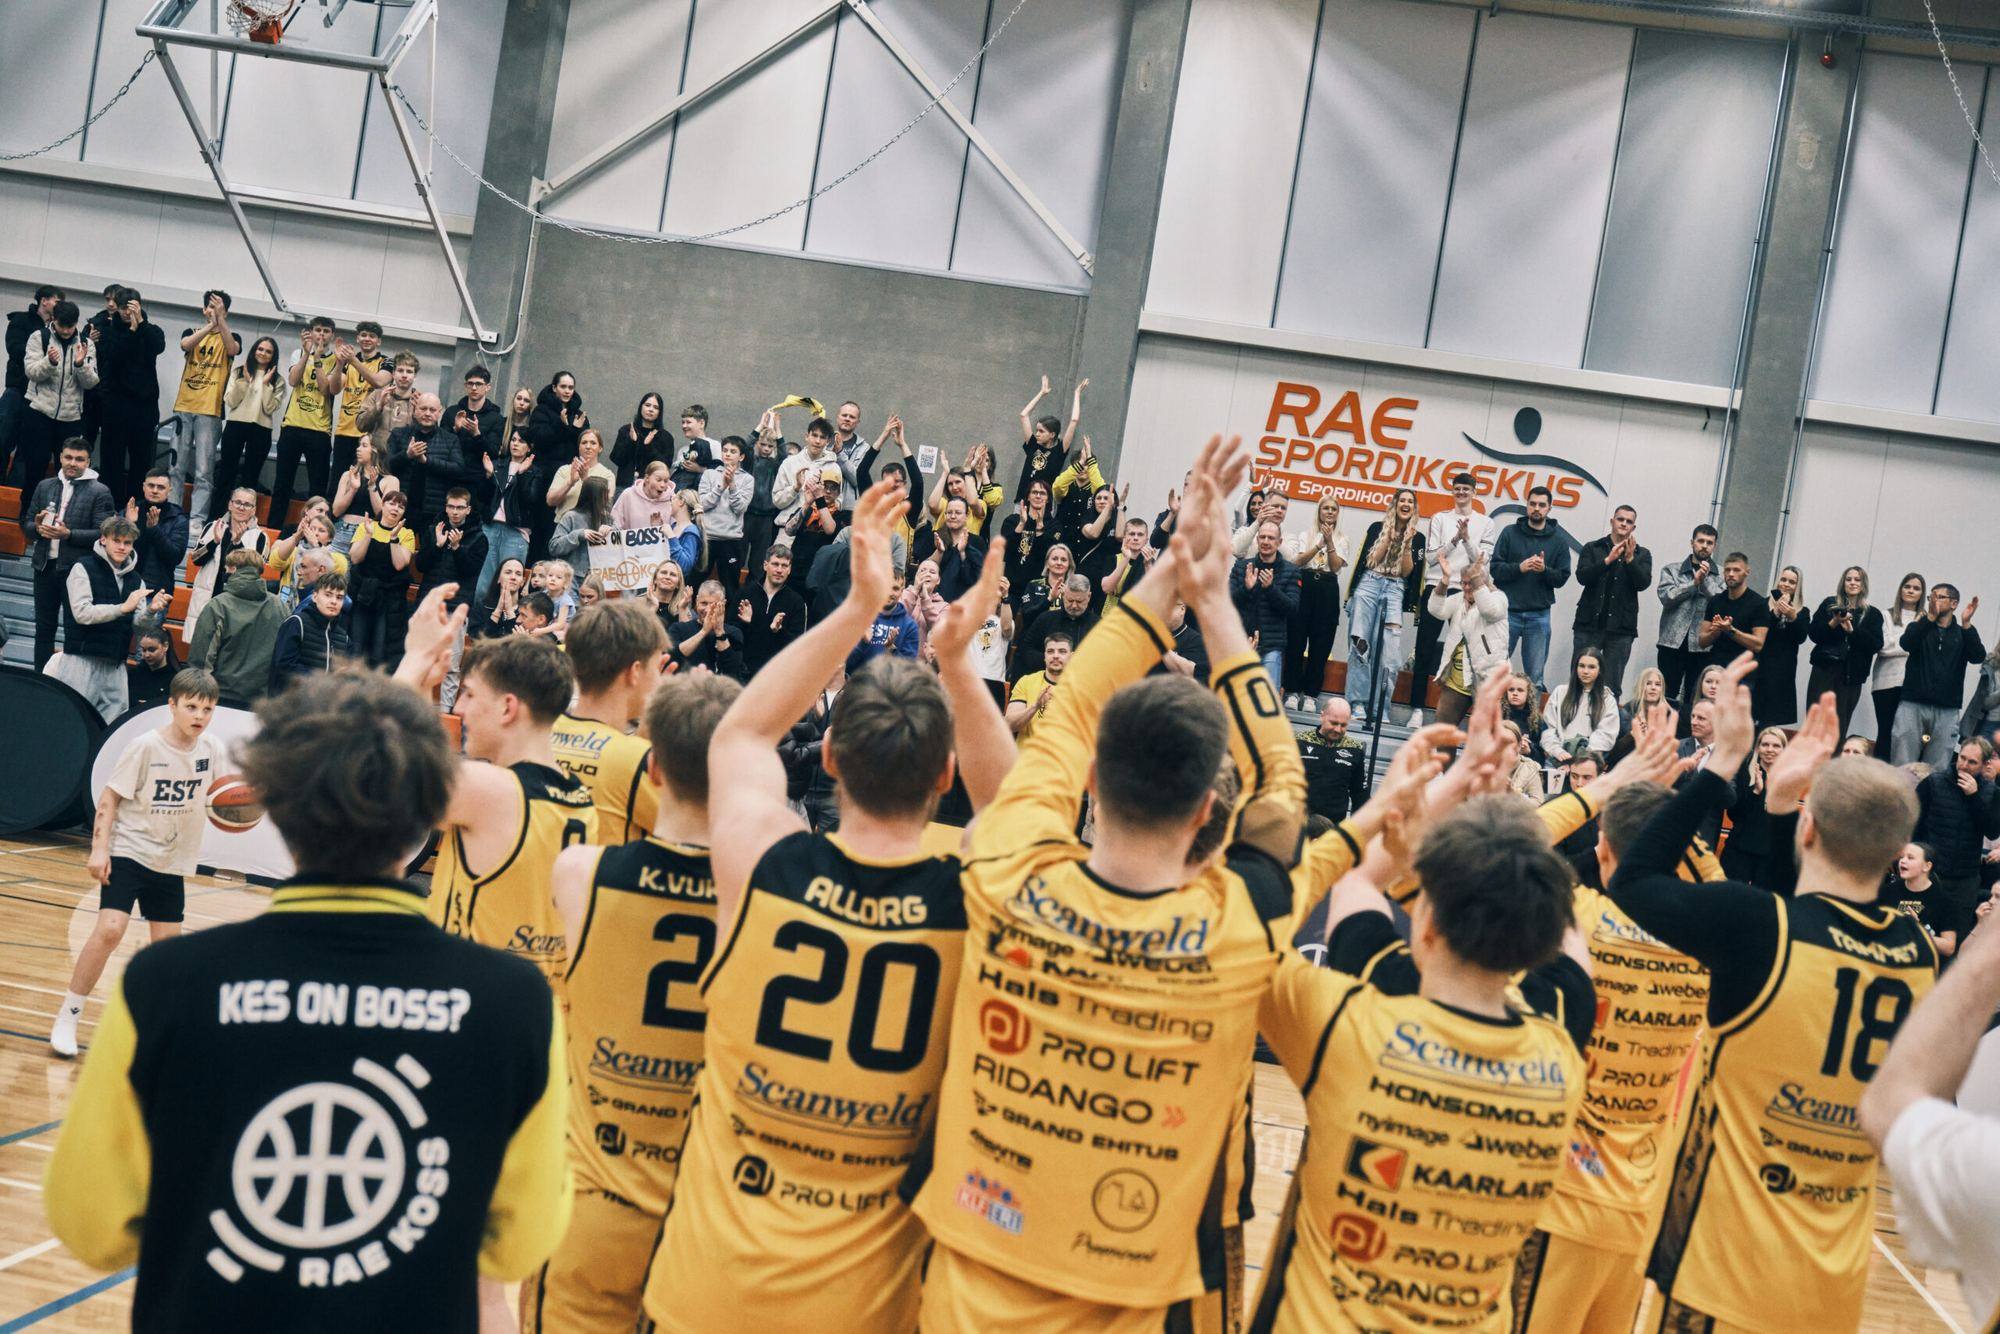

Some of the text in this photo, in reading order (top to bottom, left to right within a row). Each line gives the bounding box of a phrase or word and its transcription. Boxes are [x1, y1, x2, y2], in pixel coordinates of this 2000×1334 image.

[1265, 381, 1420, 450] RAE
[1255, 435, 1585, 508] SPORDIKESKUS
[152, 779, 203, 802] EST
[804, 876, 928, 927] ALLORG
[1015, 875, 1209, 954] Scanweld
[219, 979, 471, 1033] KES ON BOSS?
[755, 920, 941, 1074] 20
[1069, 994, 1215, 1043] Trading
[1820, 967, 1914, 1083] 18
[1040, 1032, 1201, 1086] PRO LIFT
[1386, 1021, 1566, 1085] Scanweld
[736, 1061, 932, 1128] Scanweld
[973, 1054, 1154, 1125] RIDANGO
[1002, 1106, 1084, 1144] GRAND
[298, 1137, 450, 1287] RAE KOSS
[780, 1181, 835, 1209] PRO
